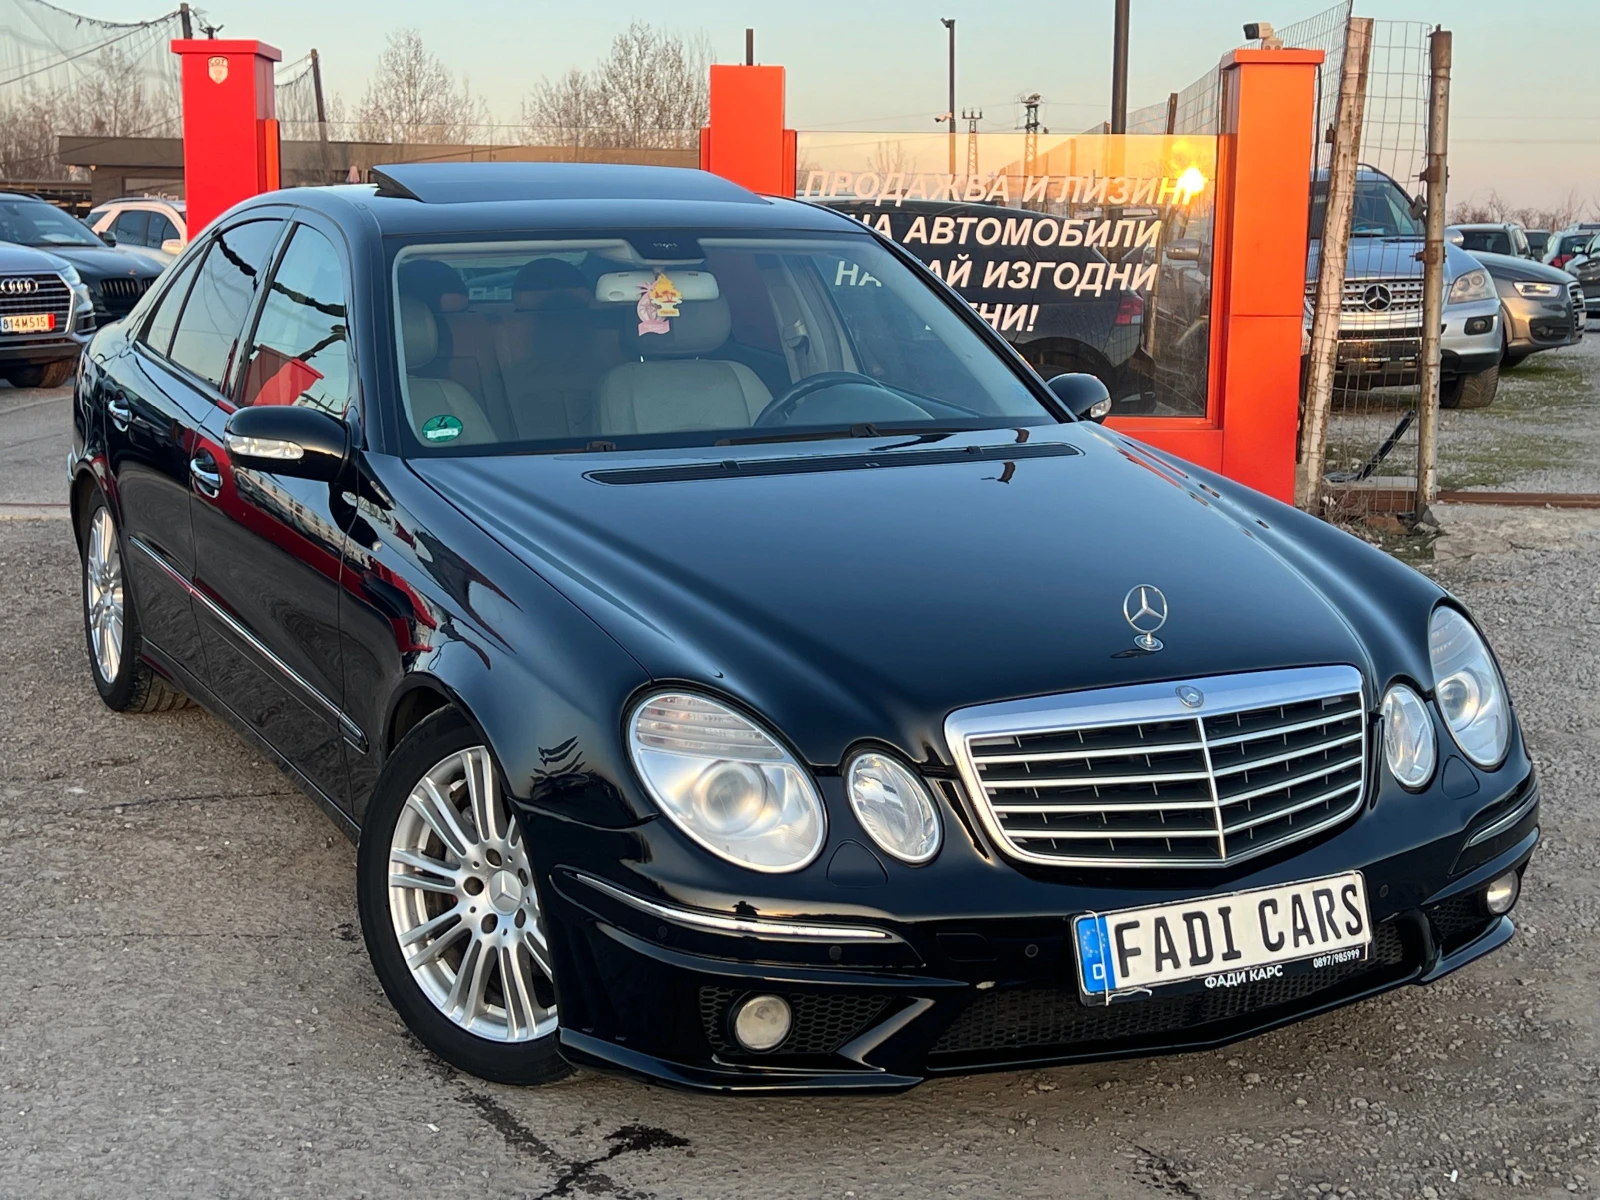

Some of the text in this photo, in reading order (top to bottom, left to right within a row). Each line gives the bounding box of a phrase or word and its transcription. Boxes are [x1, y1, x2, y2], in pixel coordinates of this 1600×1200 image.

[1022, 175, 1049, 203] И
[902, 215, 1163, 248] АВТОМОБИЛИ
[982, 261, 1159, 297] ИЗГОДНИ
[1114, 884, 1363, 978] FADI CARS
[1313, 949, 1360, 968] 0897/985999
[1204, 965, 1284, 988] ФАДИ КАРС
